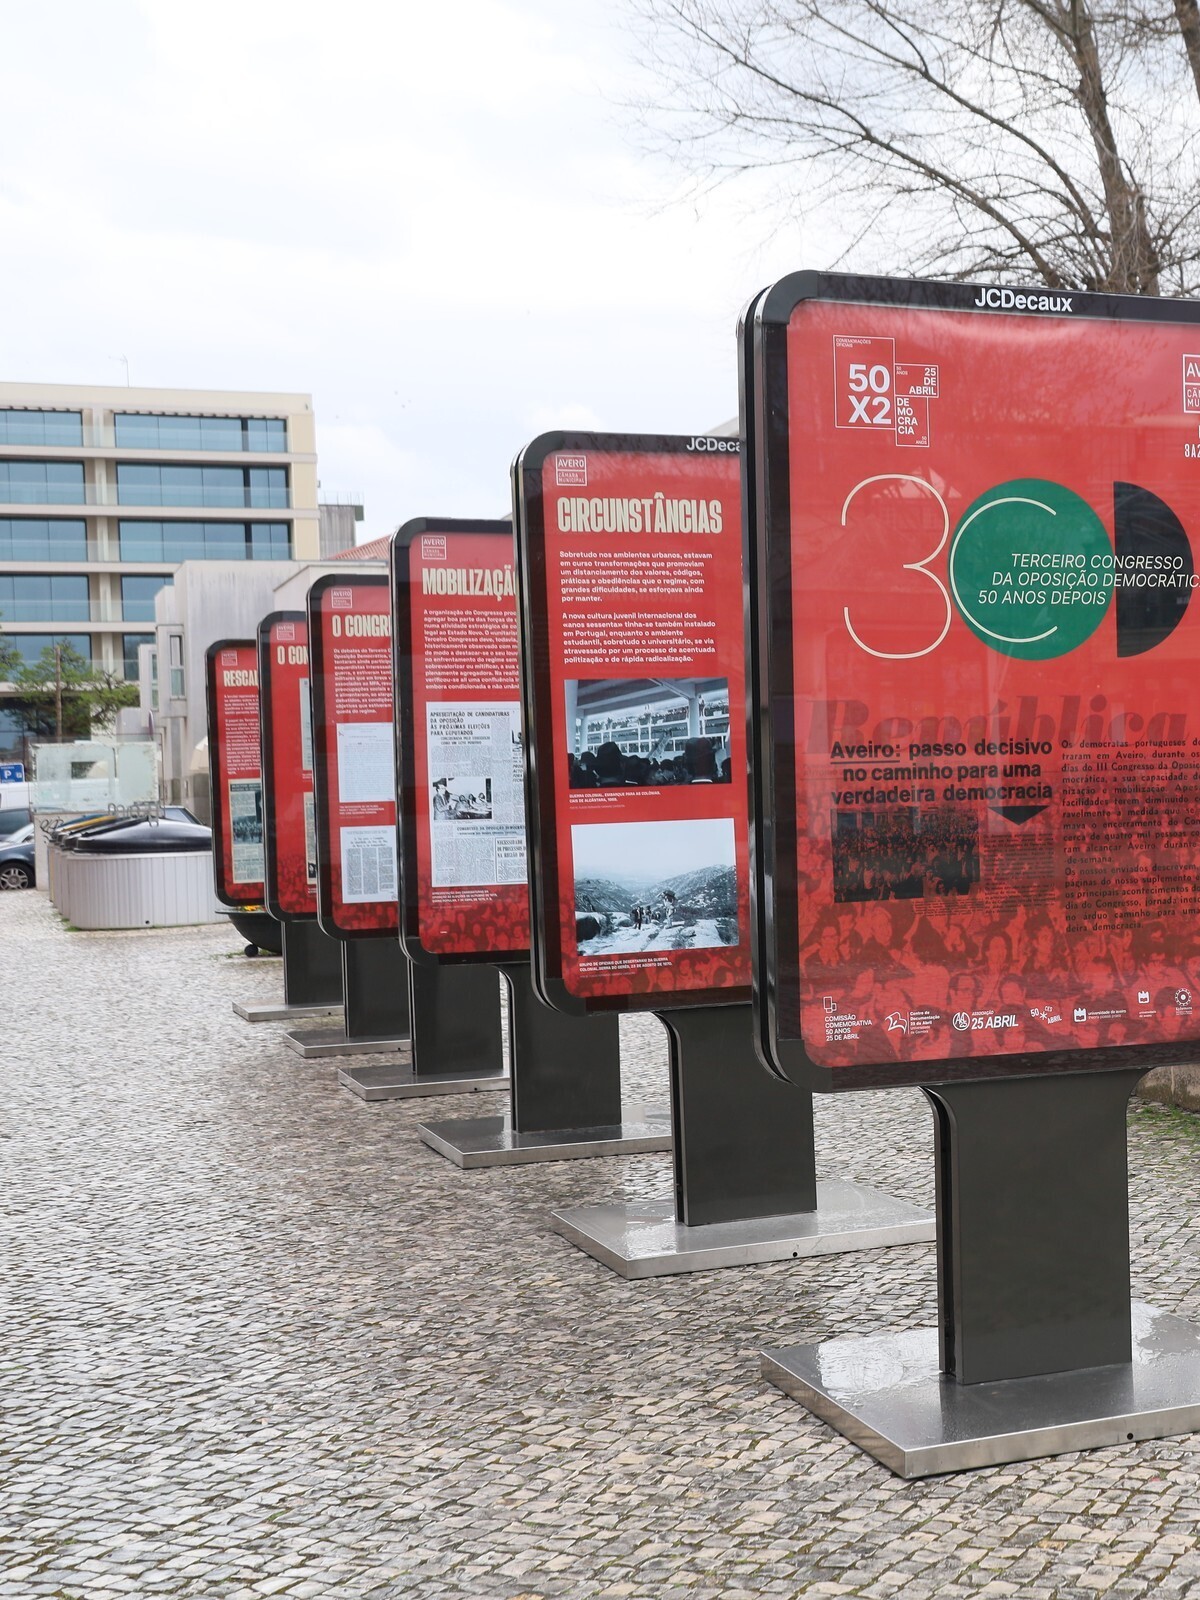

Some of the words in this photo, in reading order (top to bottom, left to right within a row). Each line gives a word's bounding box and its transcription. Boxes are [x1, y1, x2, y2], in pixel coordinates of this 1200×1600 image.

[975, 288, 1073, 312] JCDecaux
[925, 368, 936, 376] 25
[849, 364, 890, 393] 50
[924, 377, 936, 385] DE
[909, 386, 936, 395] ABRIL
[897, 398, 909, 406] DE
[848, 395, 892, 424] X2
[897, 407, 913, 416] MO
[898, 417, 918, 425] CRA
[898, 426, 914, 435] CIA
[1191, 444, 1196, 458] A
[558, 459, 584, 468] AVEIRO
[557, 492, 723, 534] CIRCUNSTÂNCIAS
[594, 560, 650, 568] transformações
[1012, 553, 1086, 568] TERCEIRO
[1091, 554, 1183, 570] CONGRESSO
[645, 569, 672, 577] valores,
[673, 569, 703, 577] códigos,
[422, 565, 516, 601] MOBILIZAÇÃ
[992, 572, 1013, 586] DA
[1018, 570, 1098, 589] OPOSIÇÃO
[592, 586, 638, 594] dificuldades,
[649, 586, 683, 594] esforçava
[978, 590, 997, 604] 50
[1002, 591, 1046, 604] ANOS
[1051, 591, 1106, 605] DEPOIS
[332, 615, 341, 637] O
[575, 630, 608, 638] Portugal,
[610, 630, 643, 638] enquanto
[277, 646, 285, 665] O
[1062, 740, 1072, 748] Os
[1080, 739, 1128, 748] democratas
[1135, 739, 1186, 748] portugueses
[830, 740, 900, 758] Aveiro:
[909, 741, 967, 760] passo
[974, 738, 1052, 756] decisivo
[1152, 750, 1185, 758] durante
[1062, 764, 1078, 772] dias
[1083, 763, 1092, 772] do
[1097, 763, 1107, 771] III
[1111, 762, 1156, 772] Congresso
[1158, 762, 1168, 770] da
[4, 770, 12, 779] P
[843, 767, 867, 782] no
[871, 762, 953, 781] caminho
[957, 764, 998, 782] para
[1003, 763, 1041, 777] uma
[831, 786, 934, 805] verdadeira
[943, 782, 1052, 801] democracia
[1101, 877, 1111, 886] do
[1115, 877, 1138, 885] nosso
[1142, 874, 1191, 884] suplemento
[1114, 909, 1150, 919] caminho
[1157, 909, 1176, 917] para
[1030, 1008, 1039, 1017] 50
[825, 1014, 856, 1022] COMISSÃO
[971, 1017, 983, 1029] 25
[985, 1015, 1018, 1028] ABRIL
[1047, 1015, 1062, 1024] ABRIL
[825, 1020, 872, 1028] COMEMORATIVA
